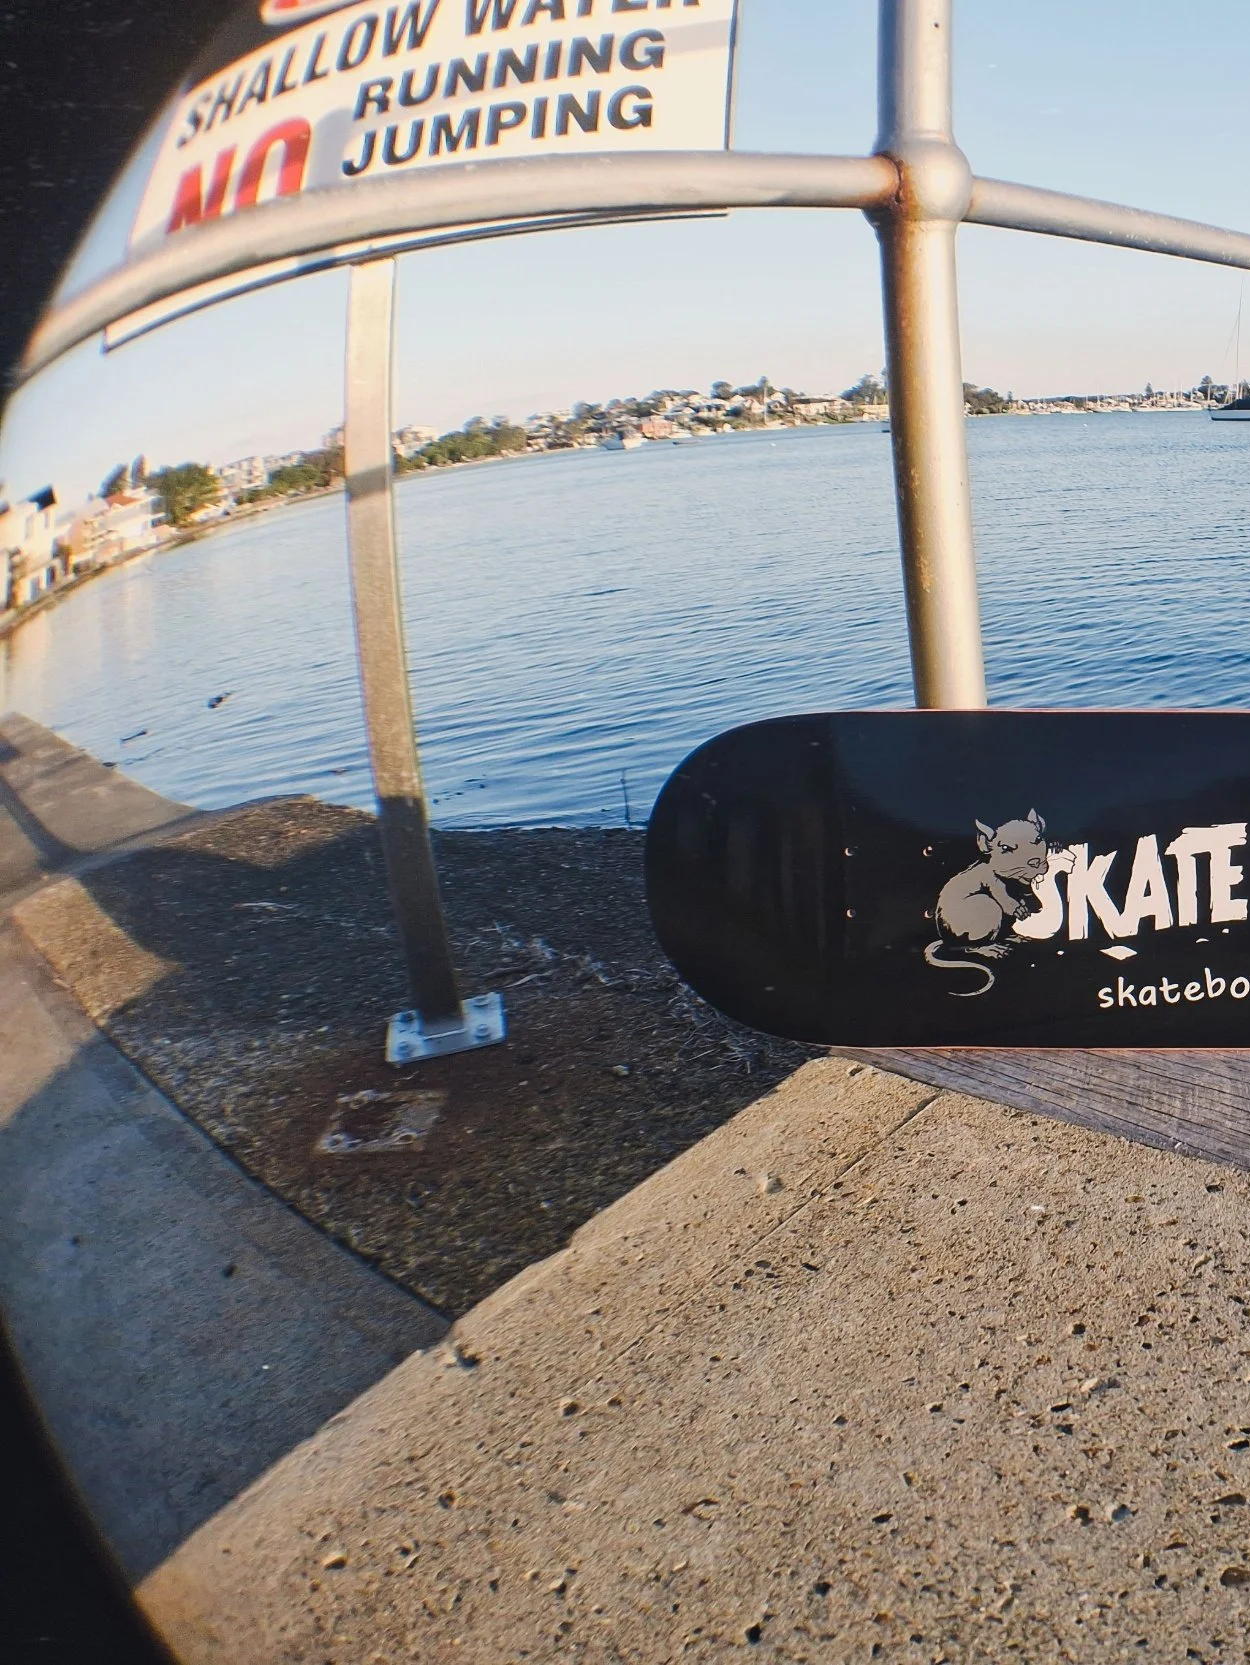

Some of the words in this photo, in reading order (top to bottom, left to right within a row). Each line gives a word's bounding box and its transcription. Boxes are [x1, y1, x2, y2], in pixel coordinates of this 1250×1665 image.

[175, 0, 441, 149] SHALLOW
[342, 84, 654, 177] JUMPING
[352, 28, 665, 122] RUNNING
[166, 116, 312, 235] NO
[1011, 822, 1249, 941] SKATE
